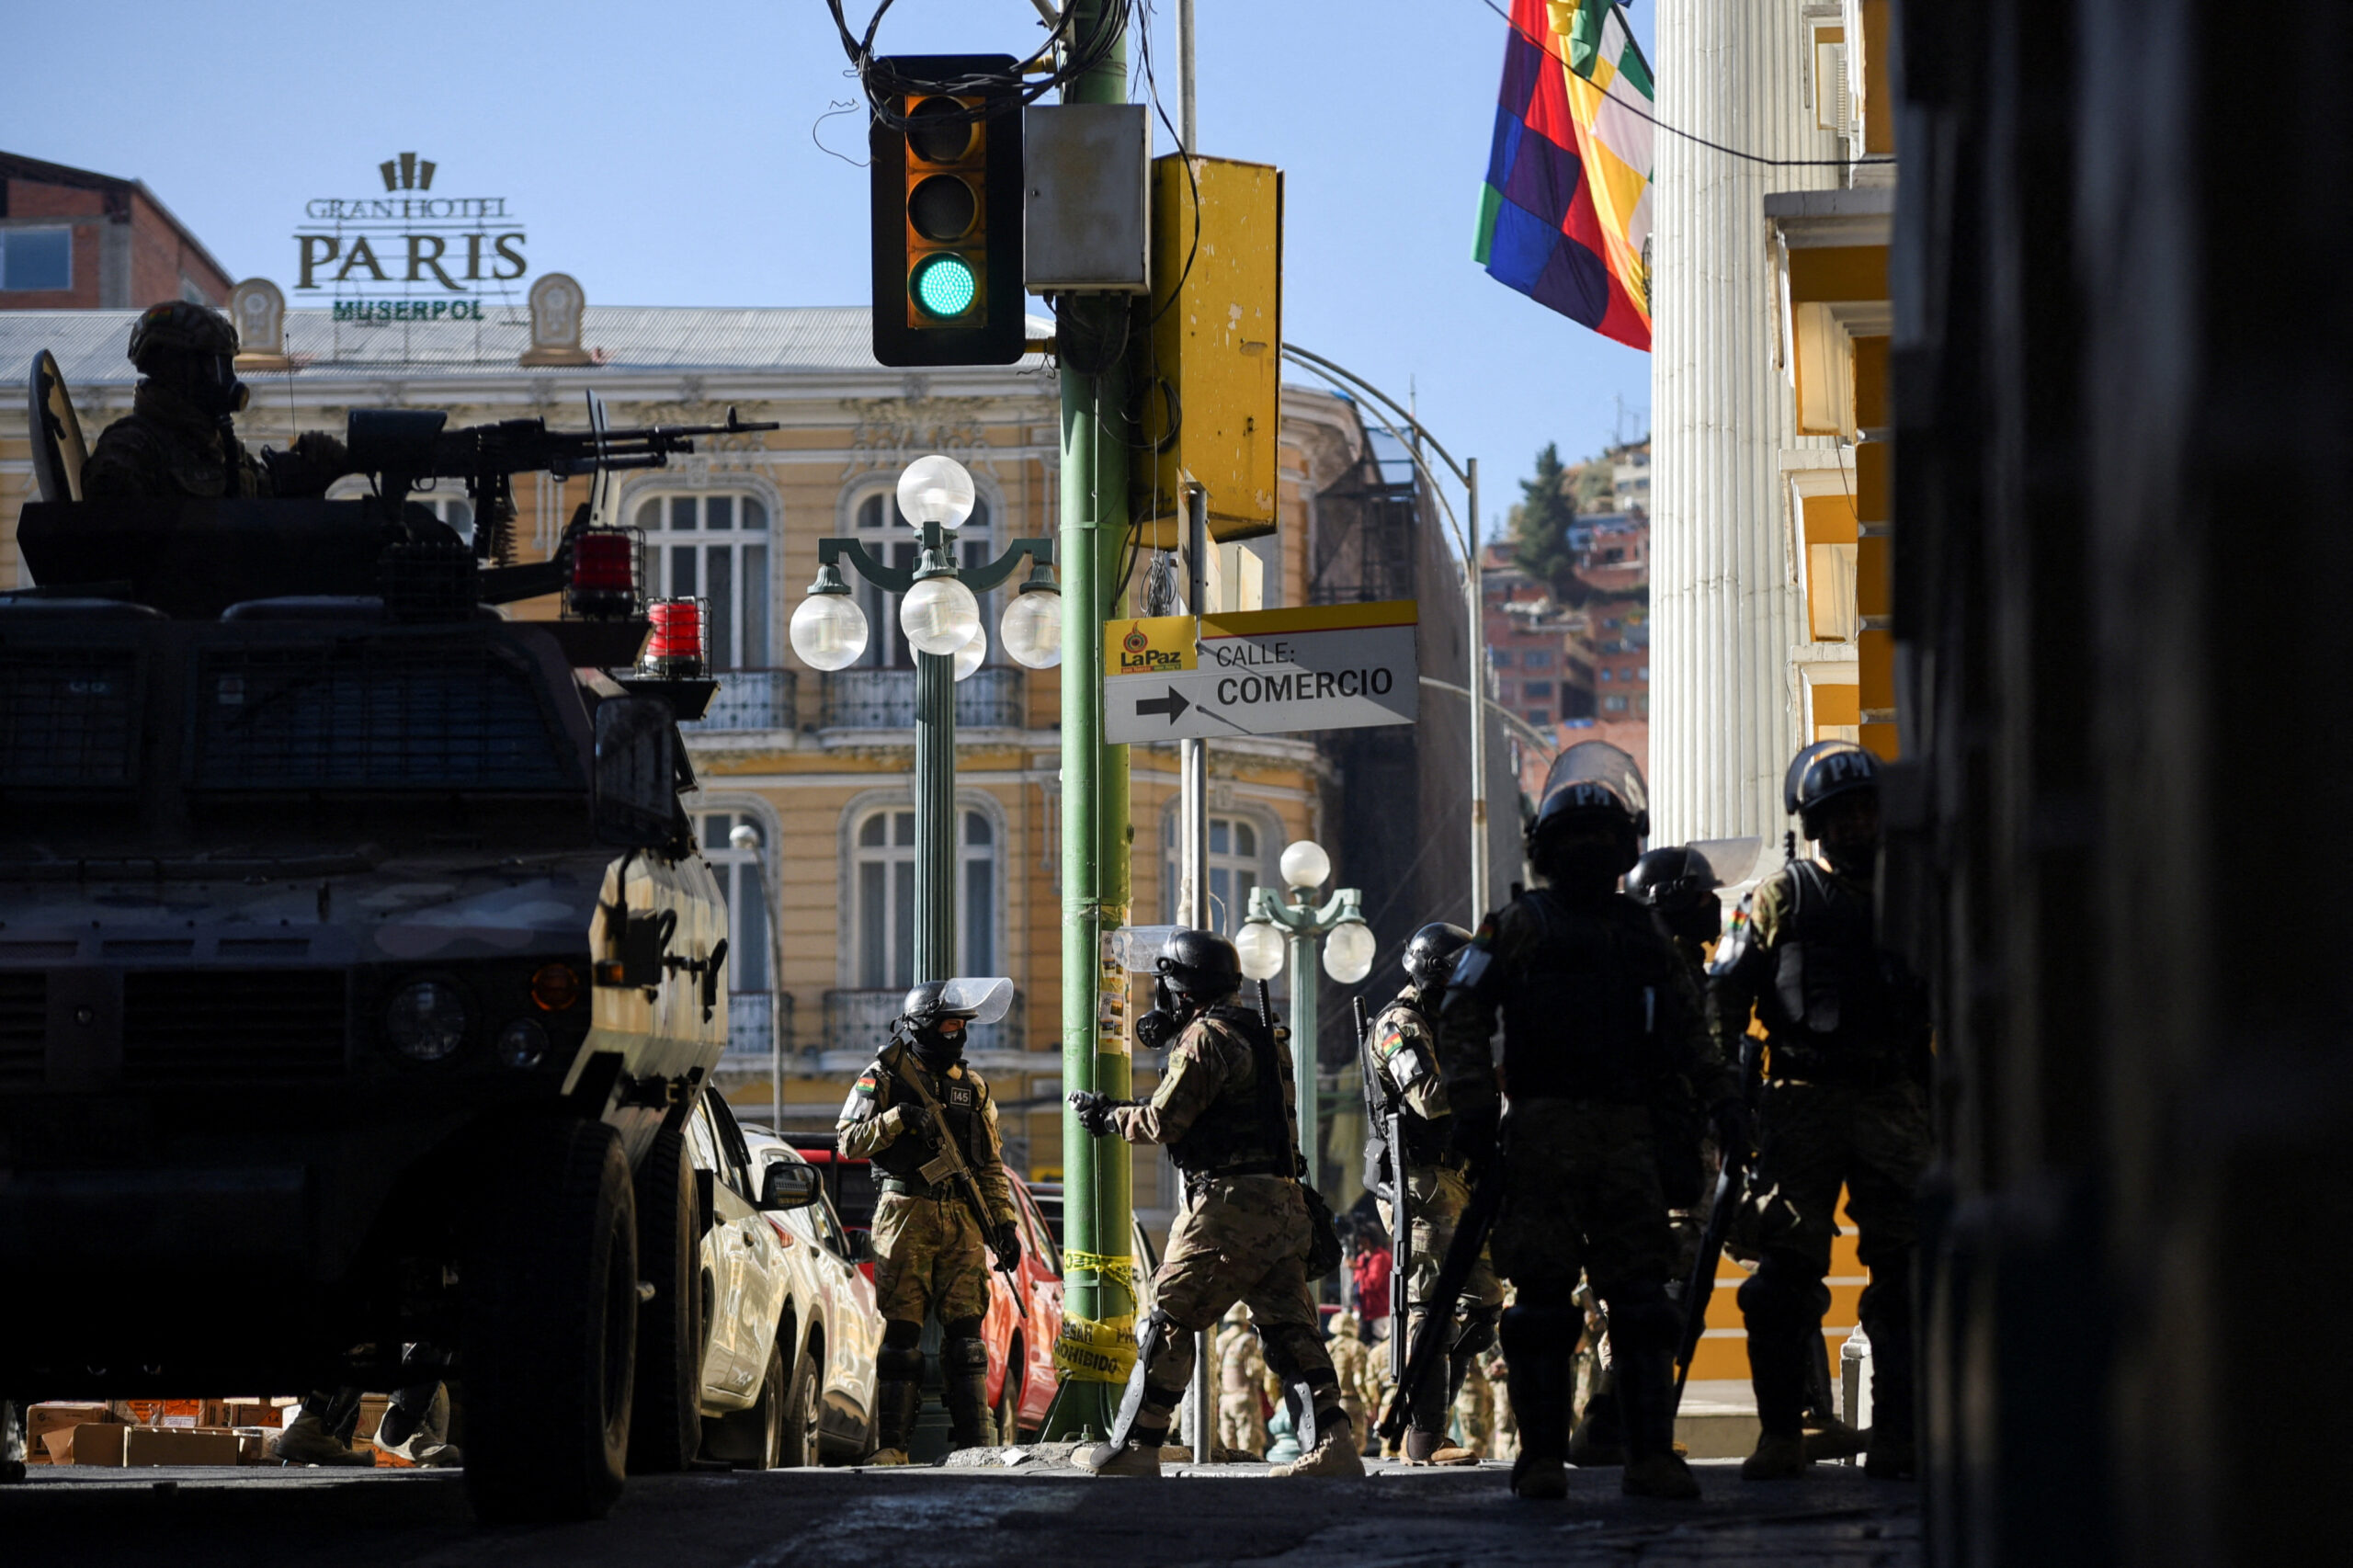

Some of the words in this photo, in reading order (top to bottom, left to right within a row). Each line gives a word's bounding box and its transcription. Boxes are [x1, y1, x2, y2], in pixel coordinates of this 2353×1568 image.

[305, 199, 393, 219] GRAN
[403, 198, 514, 218] HOTEL
[292, 233, 527, 290] PARIS
[333, 300, 484, 322] MUSERPOL
[1216, 642, 1296, 667] CALLE:
[1217, 667, 1392, 706] COMERCIO
[1829, 754, 1871, 781] PM
[1575, 784, 1610, 806] PM
[953, 1090, 969, 1103] 145
